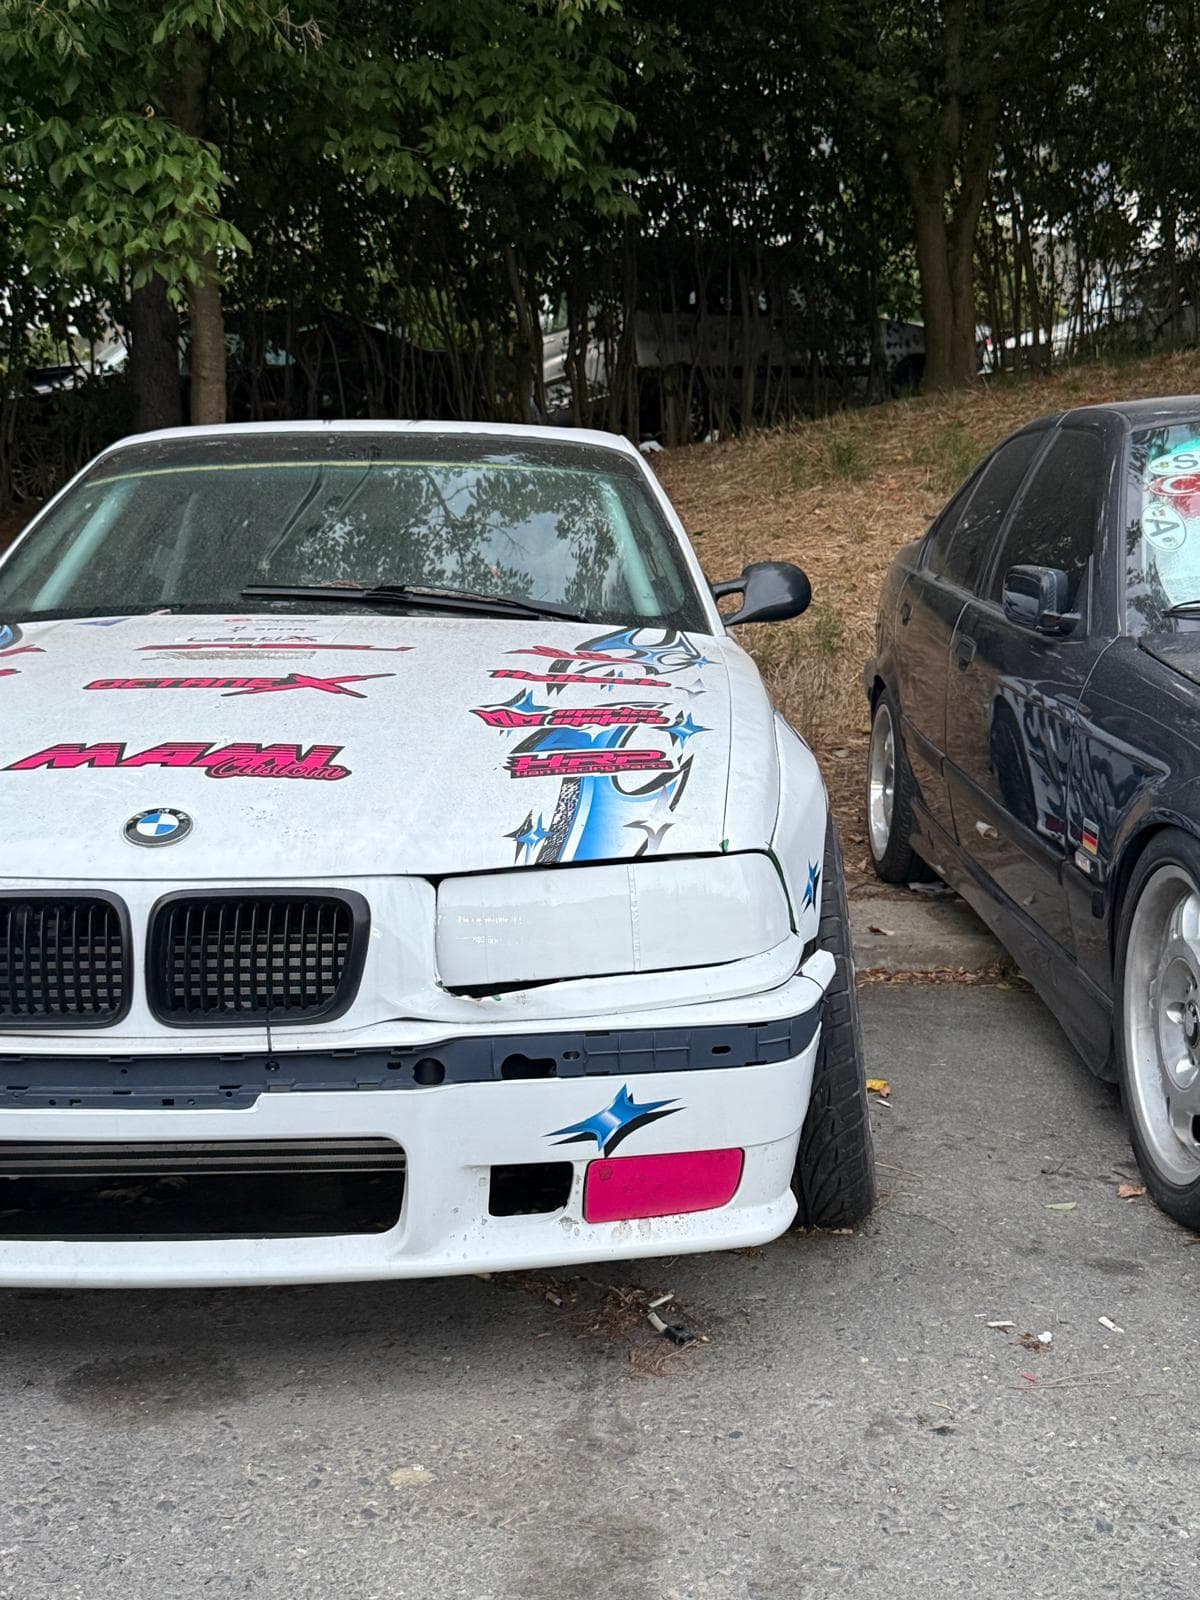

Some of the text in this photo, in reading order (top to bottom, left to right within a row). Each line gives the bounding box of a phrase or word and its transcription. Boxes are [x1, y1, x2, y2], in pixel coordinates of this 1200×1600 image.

[1145, 518, 1180, 537] A
[205, 757, 353, 781] Custom
[512, 749, 667, 769] HRP
